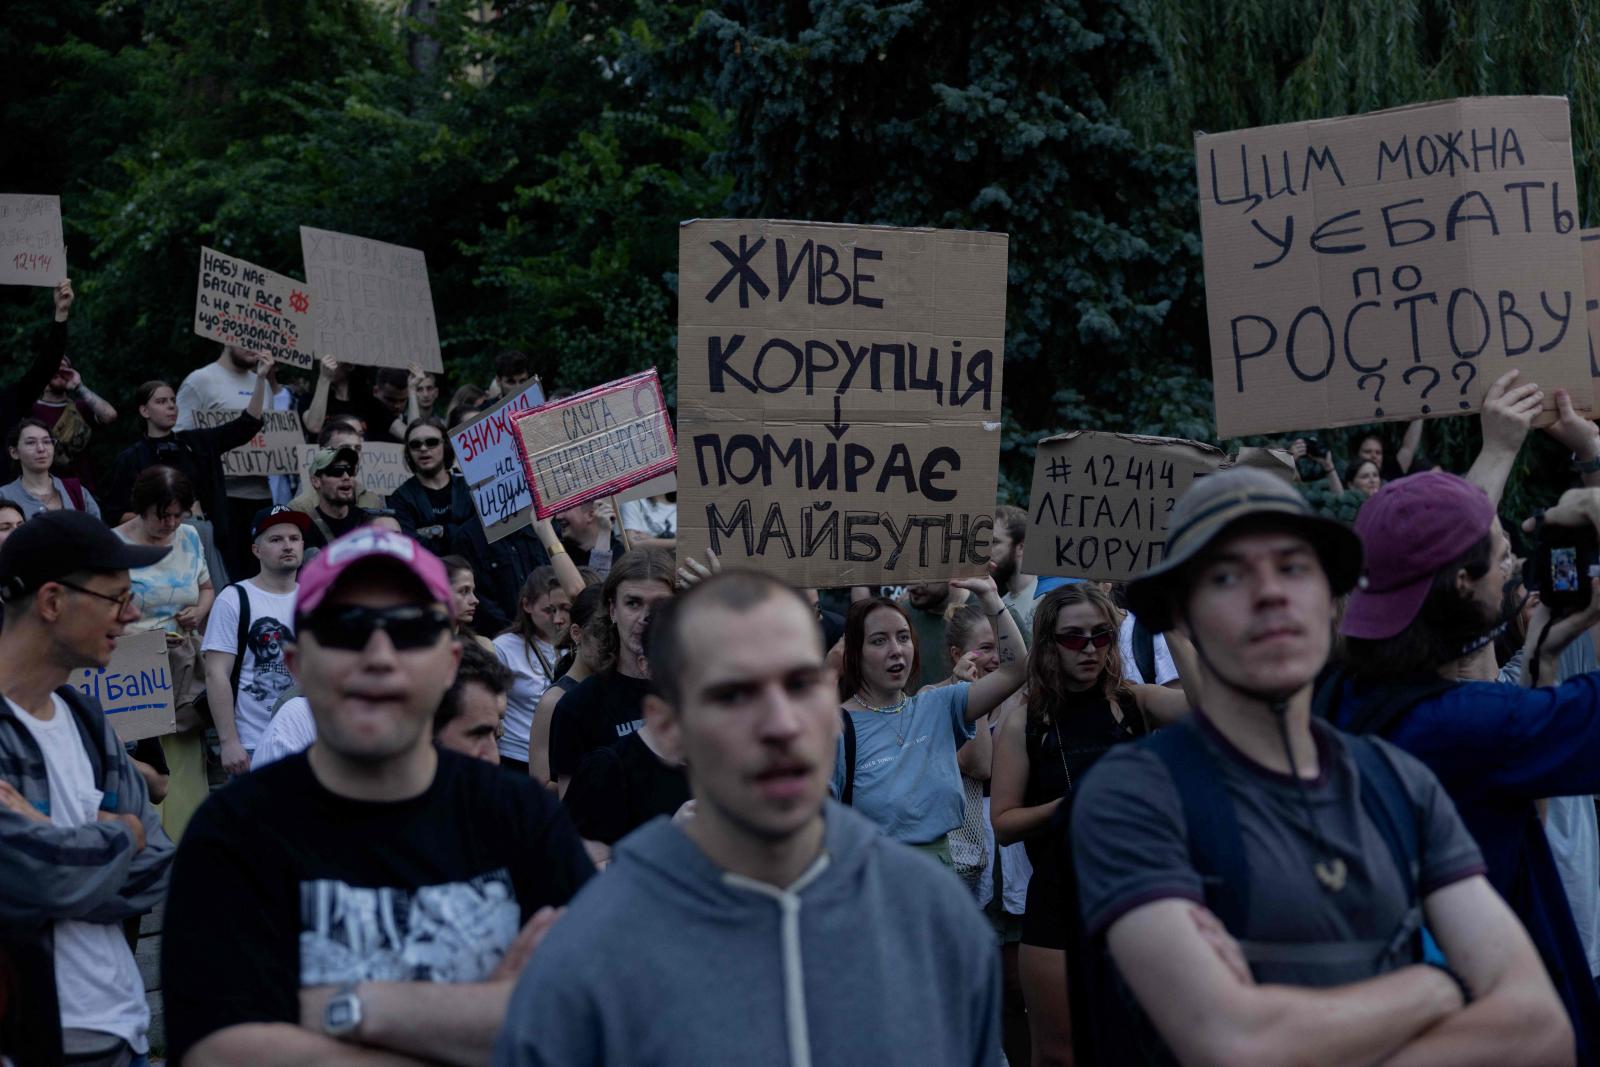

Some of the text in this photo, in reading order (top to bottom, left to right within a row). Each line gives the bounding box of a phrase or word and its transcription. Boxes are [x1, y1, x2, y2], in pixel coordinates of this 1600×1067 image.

[1210, 126, 1525, 214] ЦИМ МОЖНА
[204, 253, 238, 278] НАБУ
[705, 234, 884, 309] ЖИВЕ
[1230, 287, 1572, 393] РОСТОВУ
[562, 398, 618, 440] СЛУГА
[693, 434, 961, 502] ПОМИРАЄ
[705, 498, 994, 570] МАЙБУТНЄ
[1056, 535, 1167, 572] КОРУП
